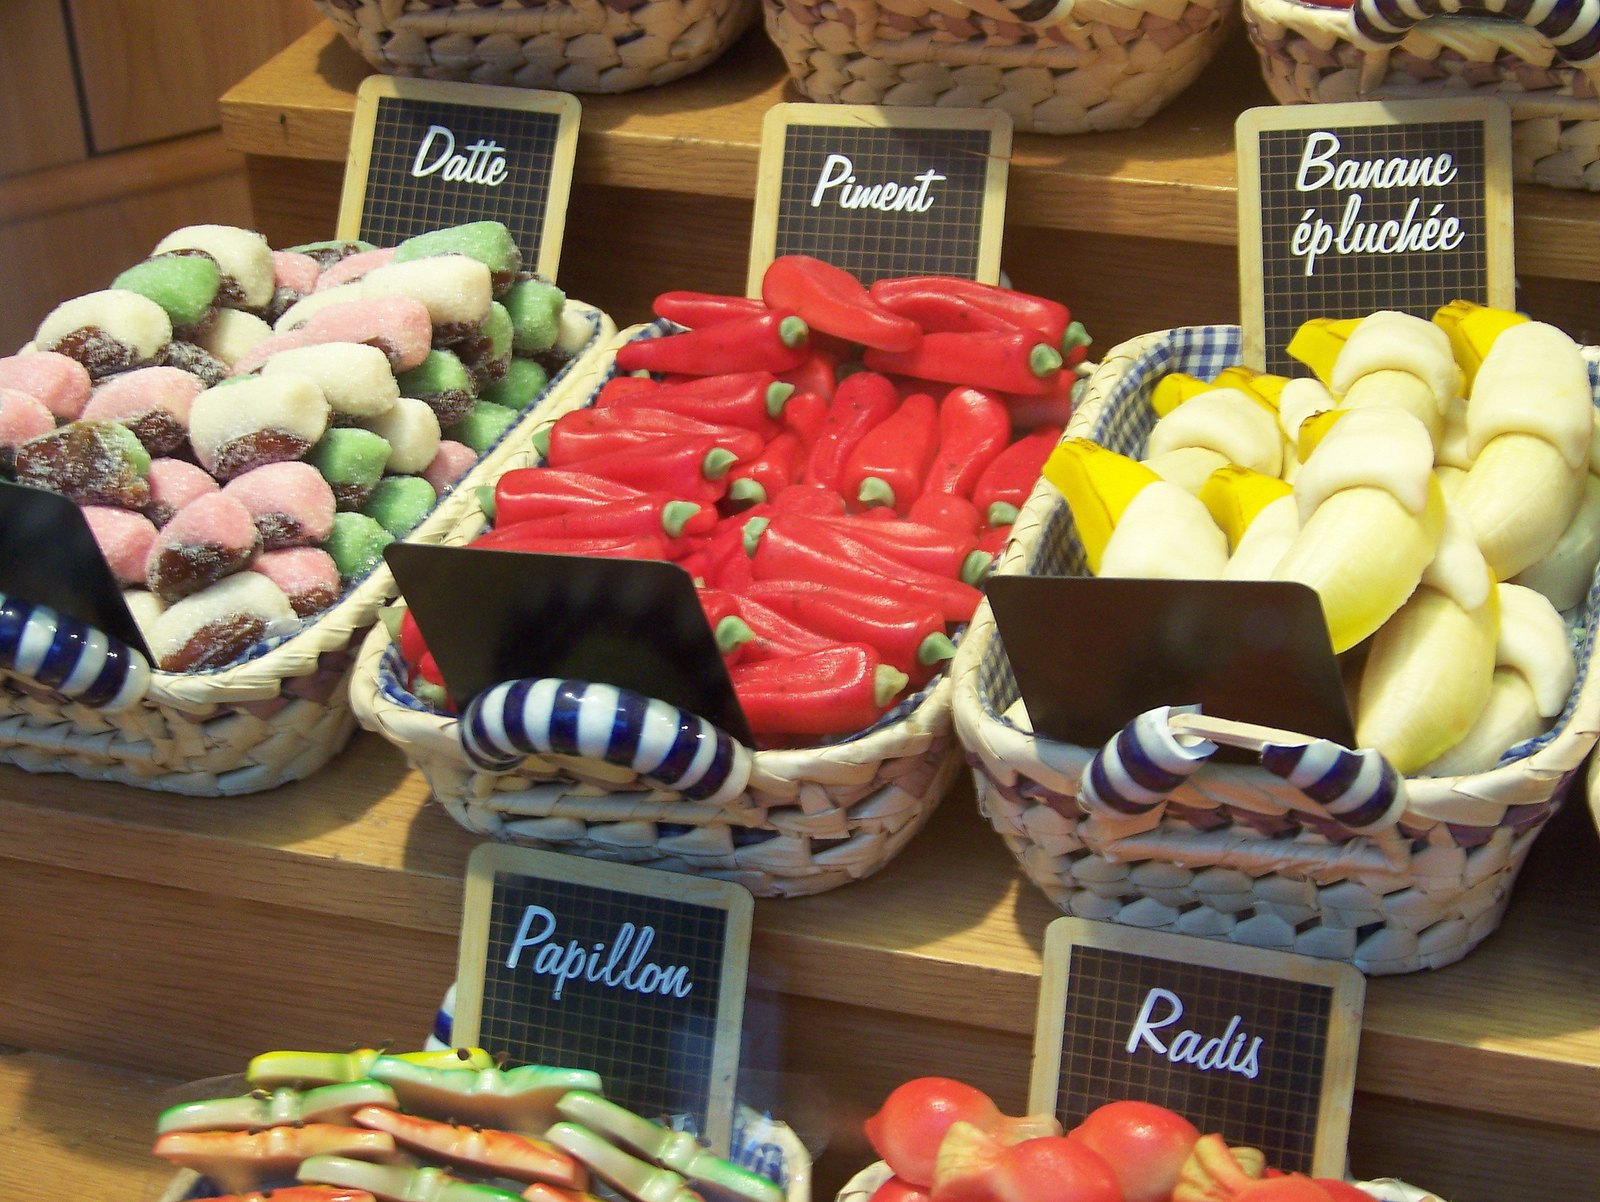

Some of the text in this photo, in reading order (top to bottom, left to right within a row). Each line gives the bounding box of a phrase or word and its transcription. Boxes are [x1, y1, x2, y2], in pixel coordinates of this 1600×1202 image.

[411, 125, 509, 186] Datte
[810, 154, 947, 213] Piment
[1296, 131, 1458, 192] Banane
[1291, 193, 1466, 277] épluchée
[505, 904, 694, 1000] Papillon
[1125, 987, 1263, 1079] Radis
